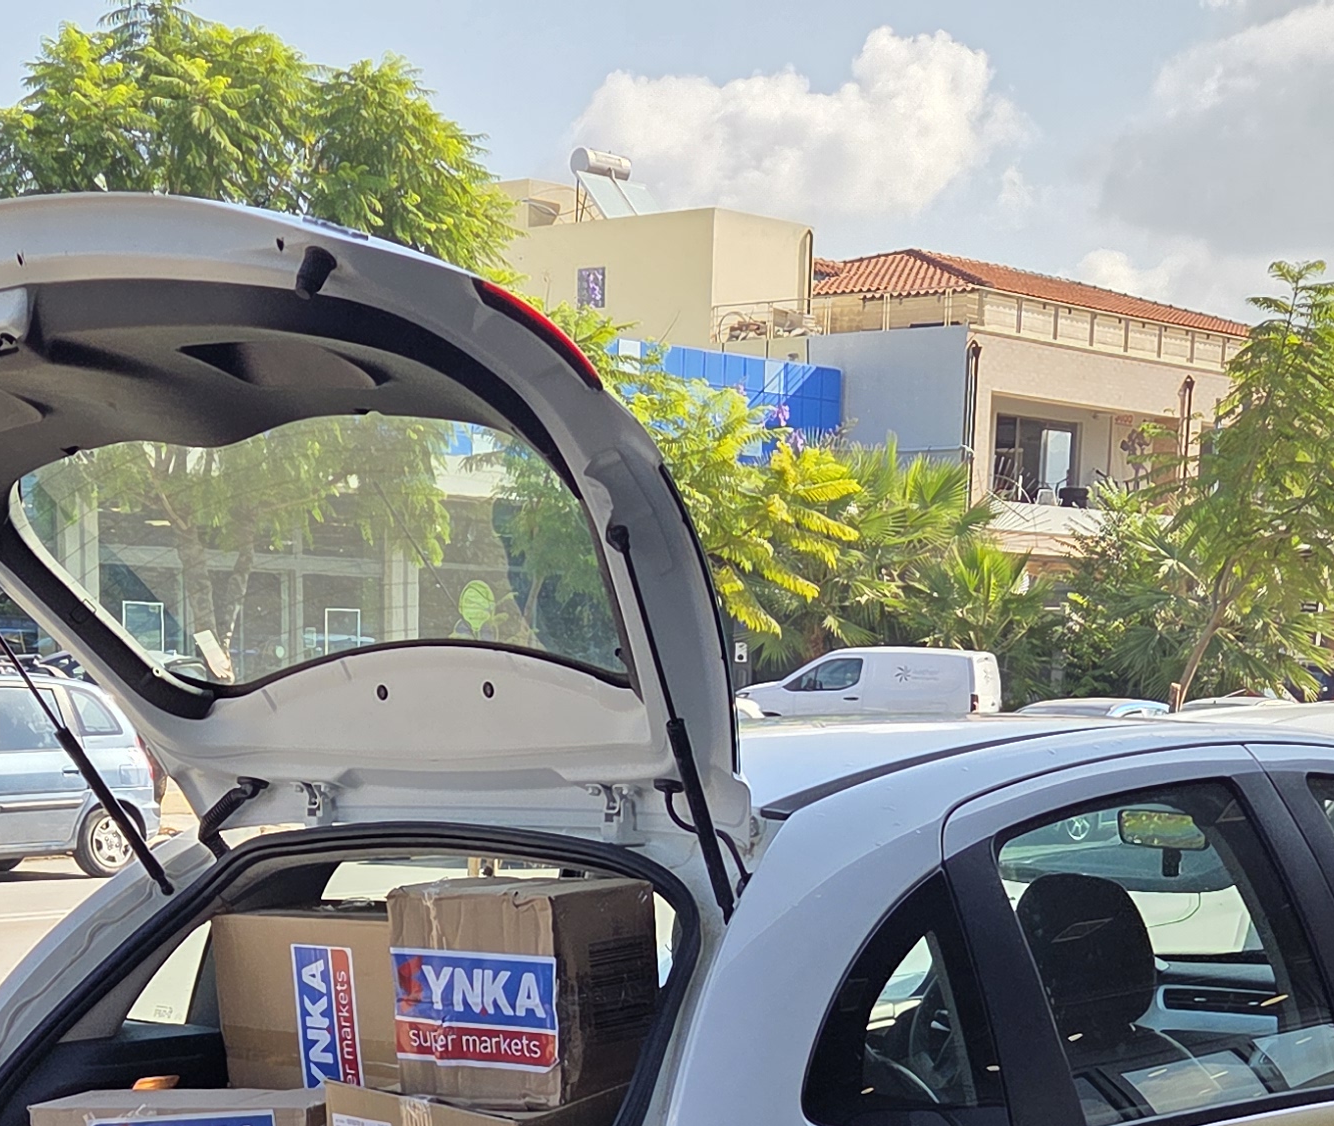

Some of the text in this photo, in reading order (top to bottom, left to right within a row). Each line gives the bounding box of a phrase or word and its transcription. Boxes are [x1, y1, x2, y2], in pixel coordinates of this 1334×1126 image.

[398, 955, 547, 1018] SYNKA
[301, 959, 334, 1089] YNKA
[408, 1029, 541, 1059] super markets
